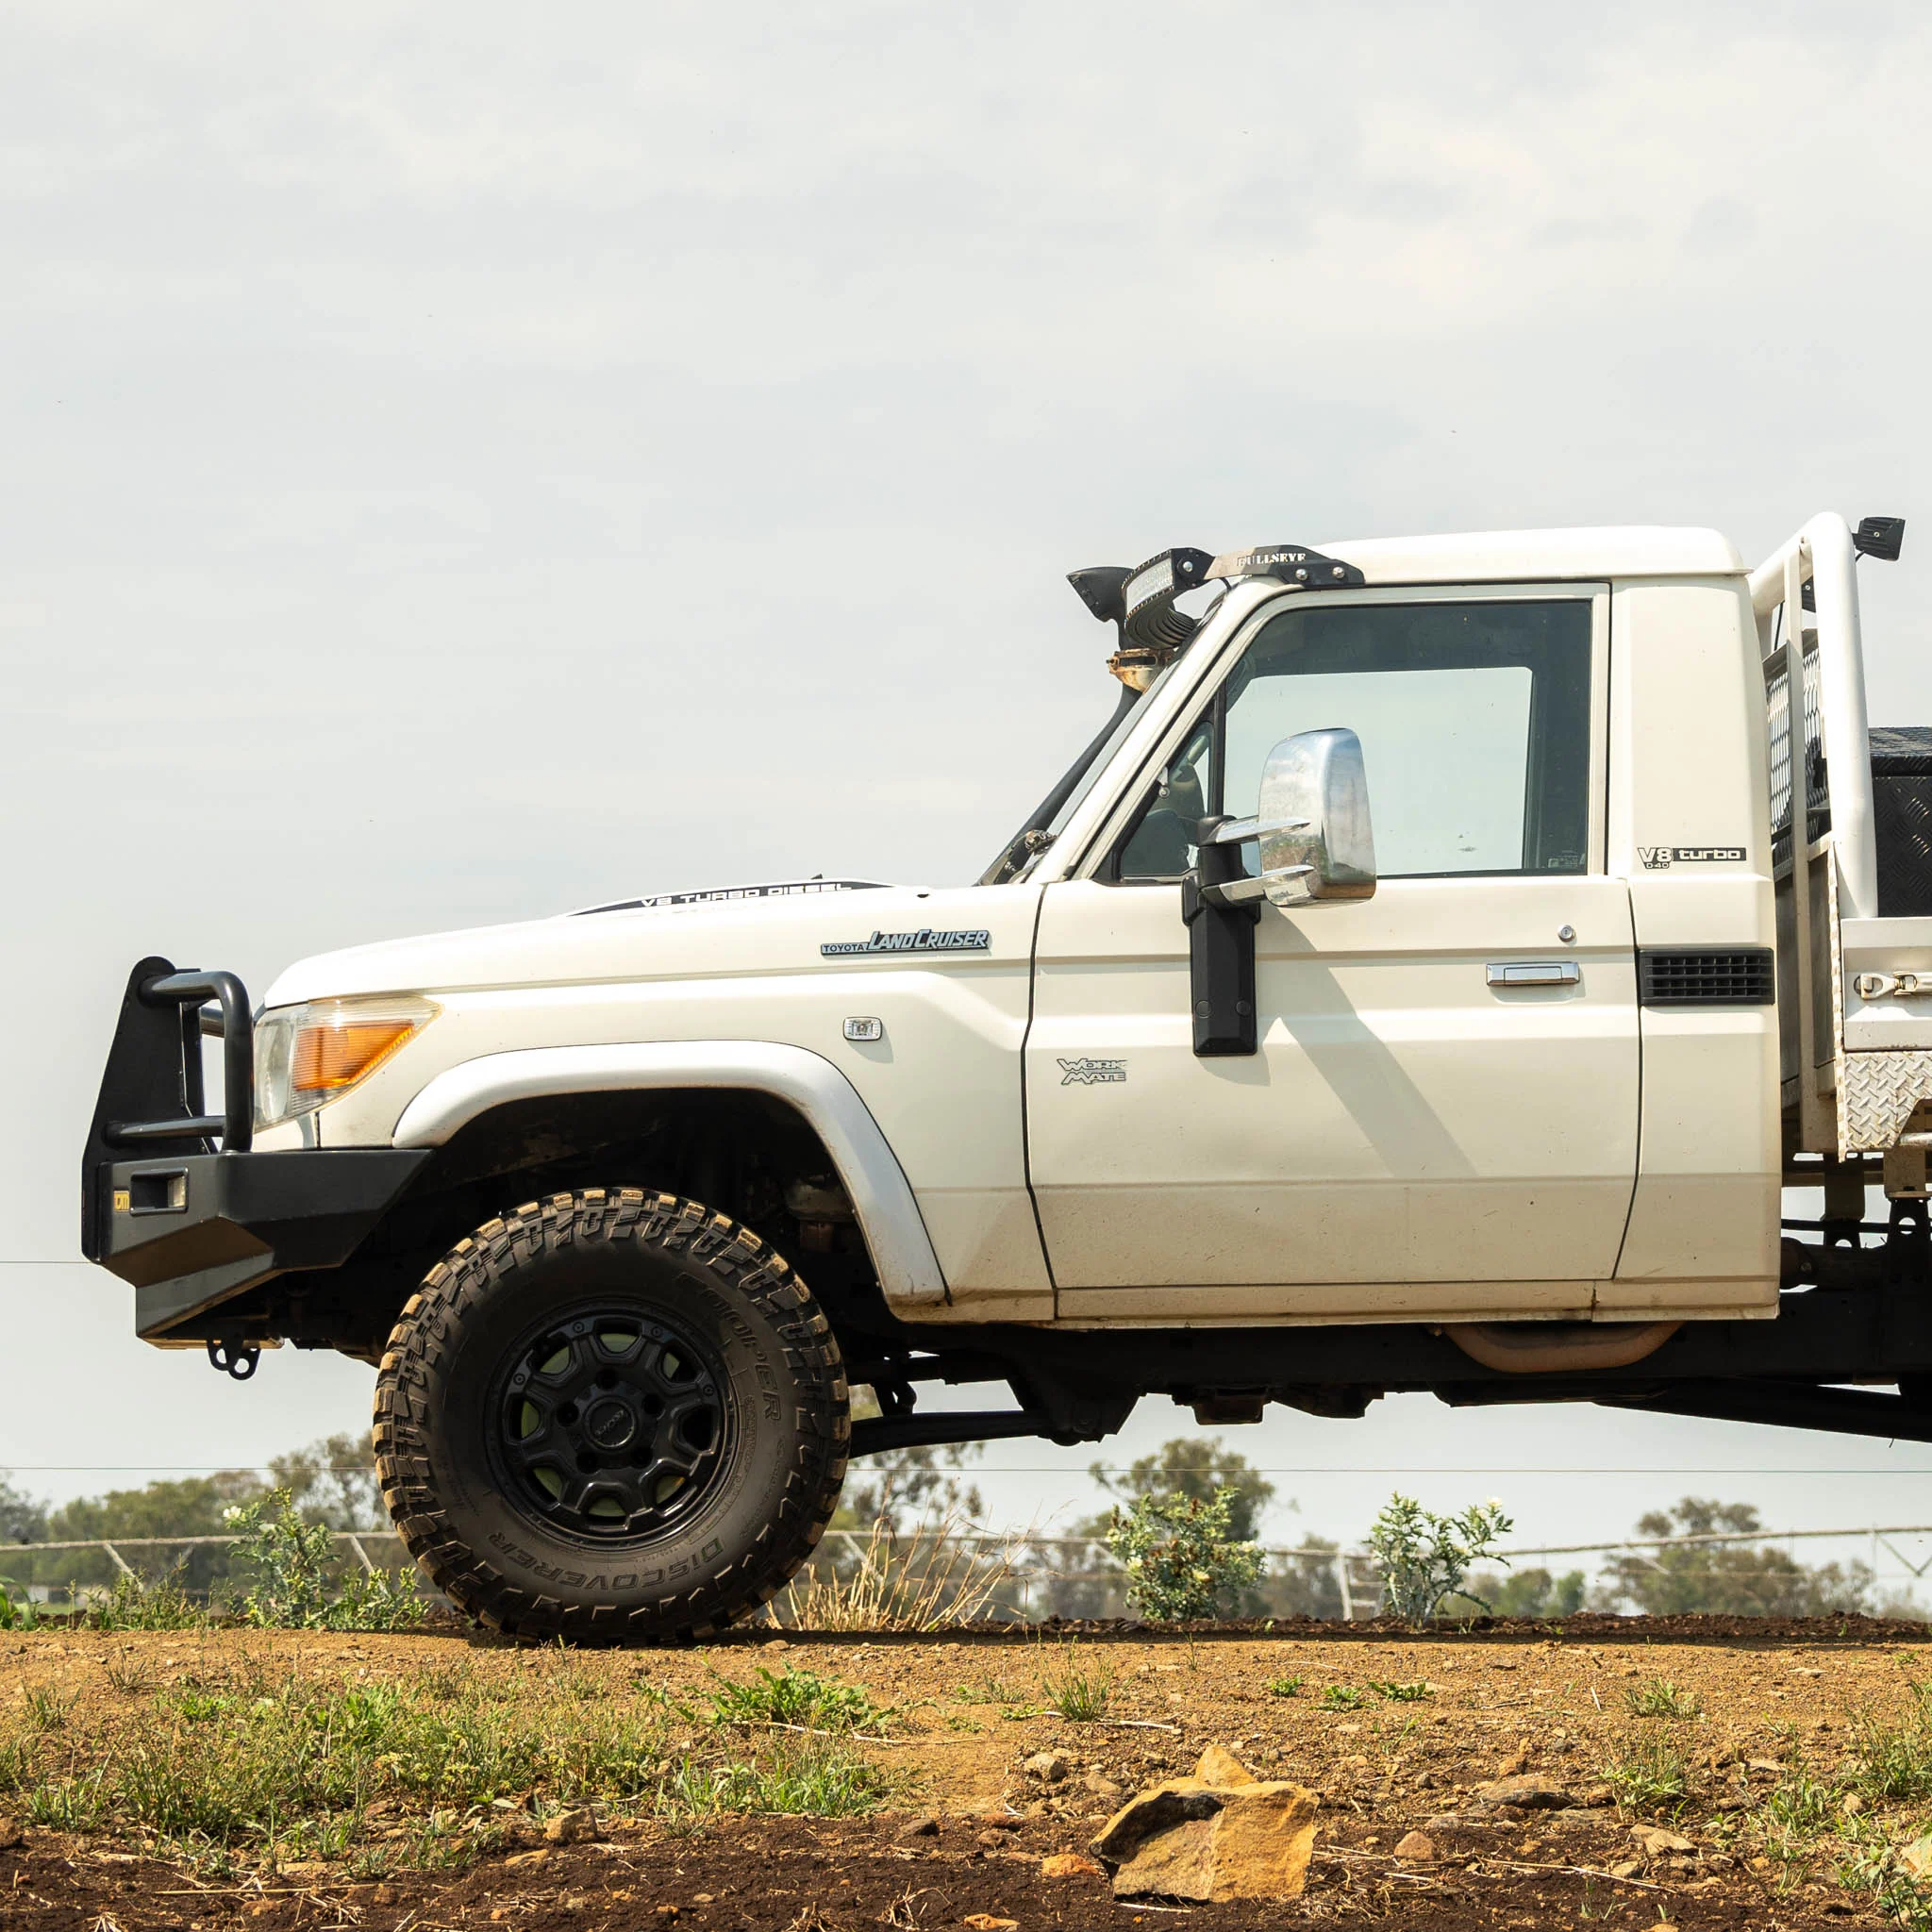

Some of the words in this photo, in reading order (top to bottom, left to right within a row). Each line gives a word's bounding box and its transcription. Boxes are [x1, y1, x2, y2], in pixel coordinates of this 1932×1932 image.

[1638, 847, 1672, 862] V8
[1679, 850, 1741, 860] turbo
[641, 896, 673, 907] V8
[680, 888, 760, 903] TURBO
[768, 883, 853, 895] DIESEL
[823, 944, 865, 953] TOYOTA
[1057, 1058, 1127, 1071] WORK
[1061, 1072, 1126, 1085] MATE
[487, 1530, 724, 1591] DISCOVERER
